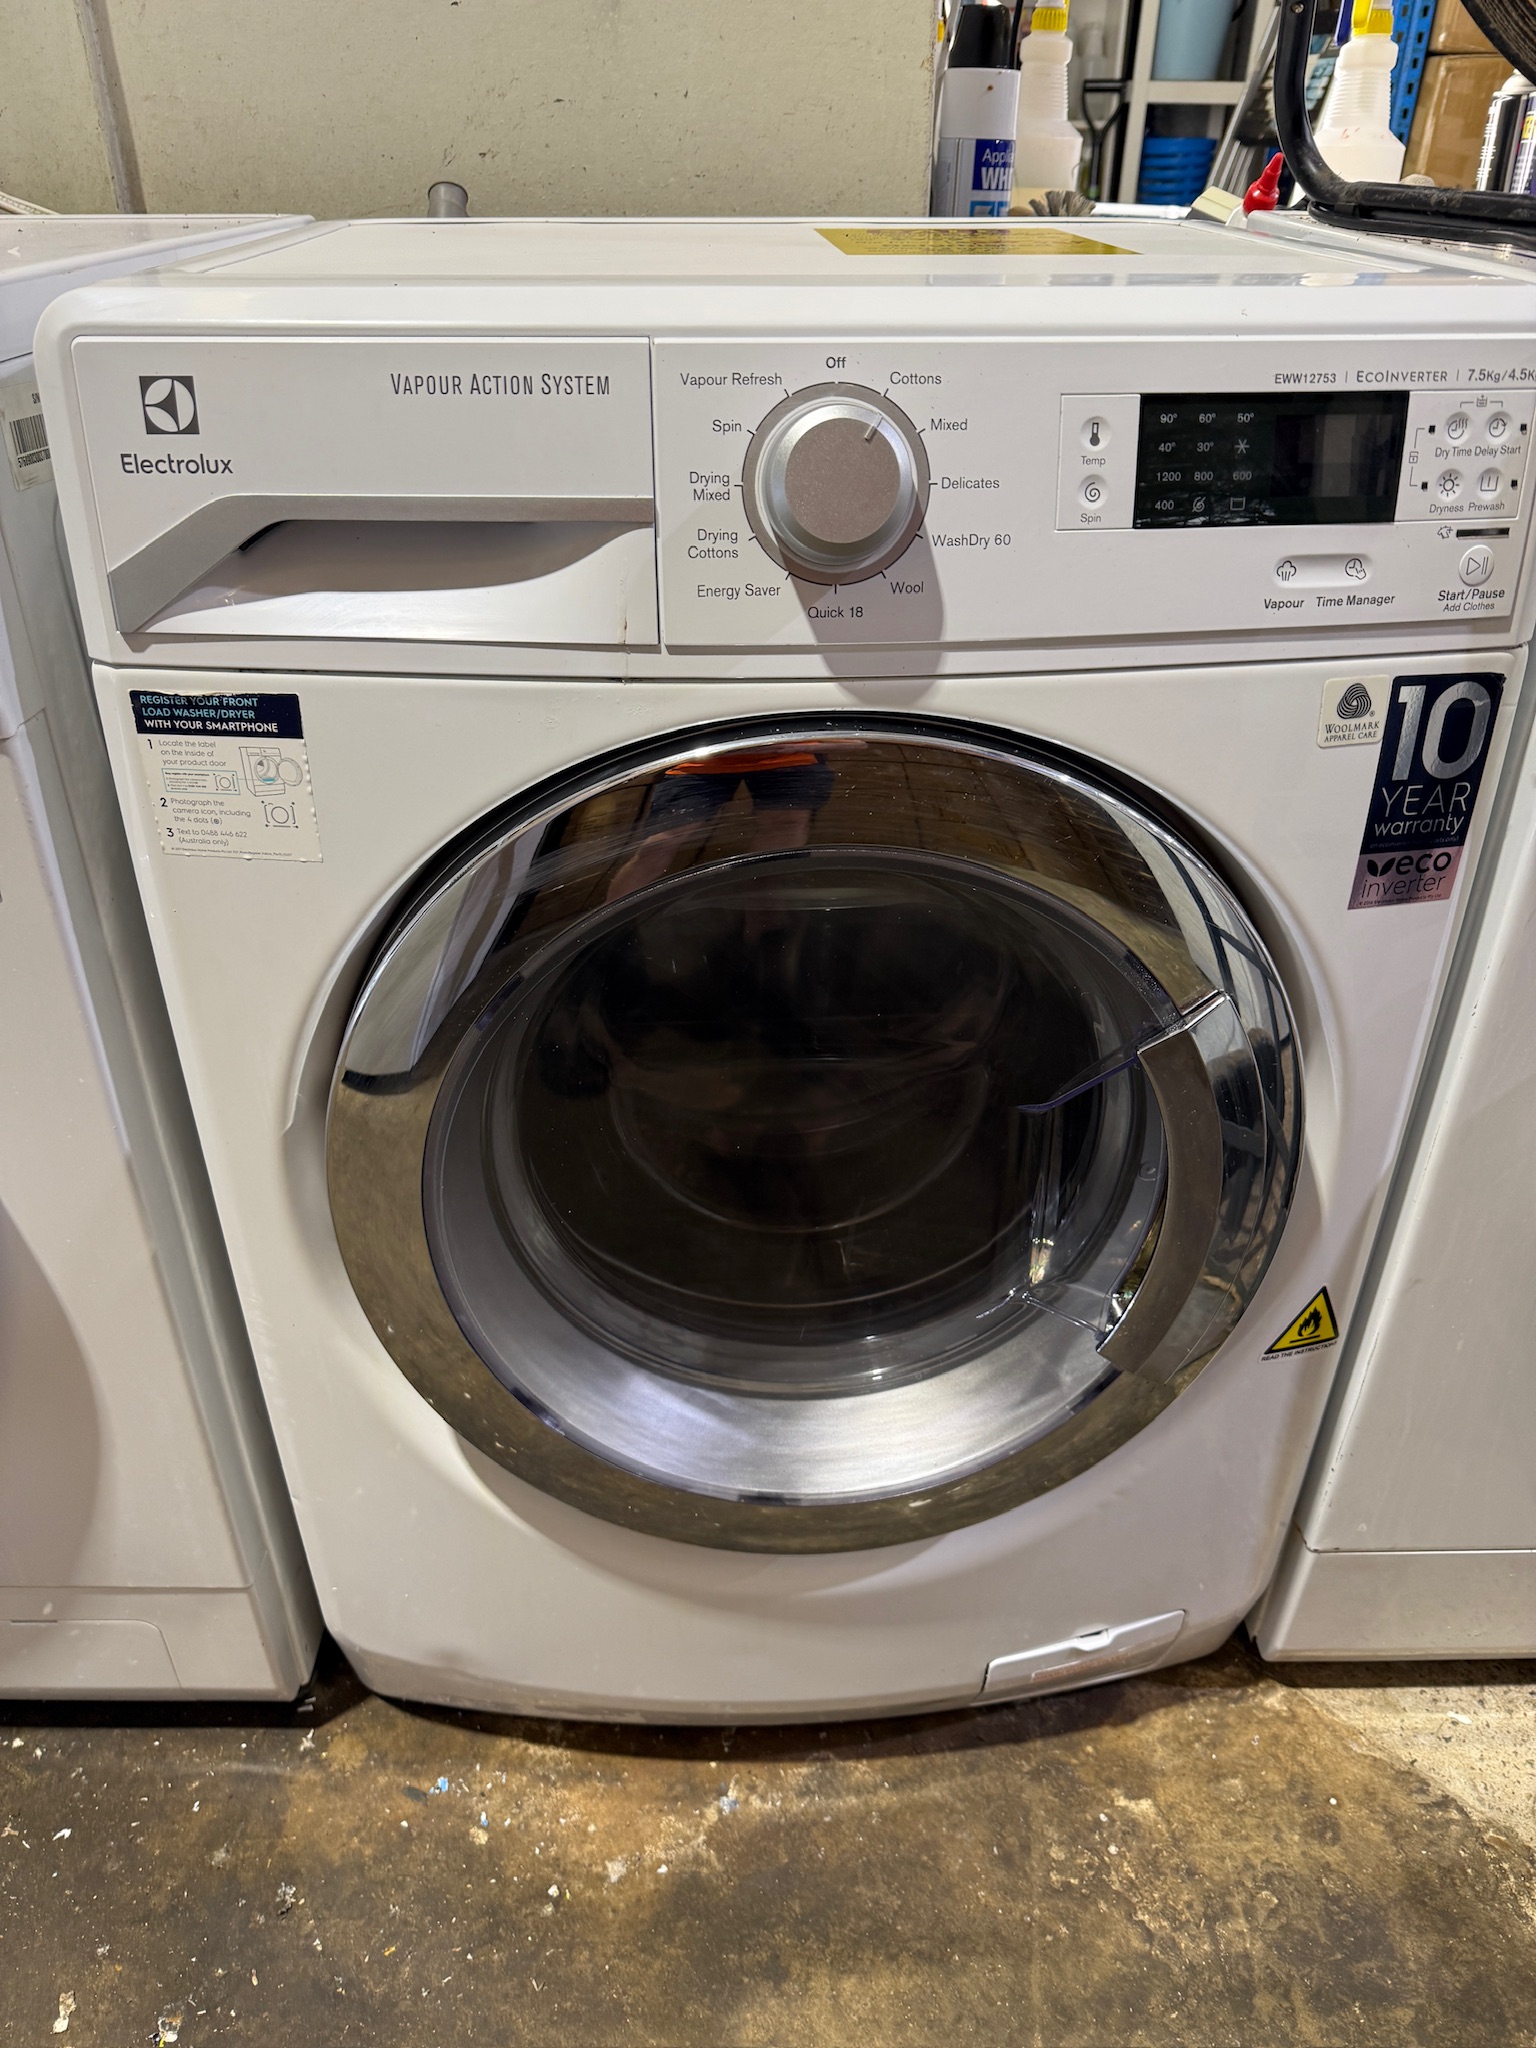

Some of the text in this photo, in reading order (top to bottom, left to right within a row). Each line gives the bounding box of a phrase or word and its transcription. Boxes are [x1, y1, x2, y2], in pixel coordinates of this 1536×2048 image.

[826, 357, 847, 369] Off
[680, 372, 783, 387] Vapour Refresh
[889, 372, 942, 386] Cottons
[1274, 373, 1337, 385] EWW12753
[1468, 368, 1536, 383] 7.5Kg/4.5K
[391, 373, 610, 395] VAPOUR ACTION SYSTEM
[712, 420, 742, 433] Spin
[930, 418, 968, 432] Mixed
[1434, 446, 1472, 459] Dry Time
[1474, 445, 1521, 459] Delay Start
[120, 453, 234, 474] Electrolux
[1081, 456, 1106, 467] Temp
[689, 472, 730, 488] Drying
[941, 476, 1000, 490] Delicates
[1156, 471, 1252, 482] 1200 800 600
[693, 489, 731, 501] Mixed
[1155, 500, 1175, 511] 400
[1429, 503, 1464, 514] Dryness
[1468, 501, 1505, 512] Prewash
[1080, 513, 1102, 525] Spin
[697, 529, 738, 545] Drying
[932, 533, 1011, 551] WashDry 60
[687, 546, 739, 560] Cottons
[697, 584, 781, 600] Energy Saver
[890, 581, 924, 594] Wool
[1438, 588, 1505, 603] Start/Pause
[1264, 594, 1396, 612] Vapour Time Manager
[1443, 601, 1495, 613] Add Clothes
[807, 606, 864, 619] Quick 18
[139, 694, 259, 708] REGISTER YOUR FRONT
[142, 707, 256, 720] LOAD WASHER/DRYER
[144, 719, 279, 733] WITH YOUR SMARTPHONE
[1325, 721, 1380, 734] WOOLMARK
[1392, 681, 1491, 781] 10
[1324, 731, 1378, 743] APPAREL CARE
[147, 739, 153, 749] 1
[158, 739, 217, 749] Locate the label
[171, 749, 183, 757] the
[184, 750, 205, 758] inside
[206, 750, 214, 758] of
[162, 759, 227, 768] your product door
[160, 797, 168, 808] 2
[170, 797, 212, 807] Photograph
[1382, 782, 1471, 818] YEAR
[172, 807, 251, 818] camera icon, including
[174, 815, 186, 823] the
[193, 816, 209, 824] dots
[1374, 814, 1465, 837] warranty
[166, 827, 174, 838] 3
[177, 828, 191, 836] Text
[178, 836, 229, 847] (Australia only)
[1395, 851, 1452, 876] eco
[1361, 875, 1446, 899] inverter
[1260, 1354, 1280, 1362] READ
